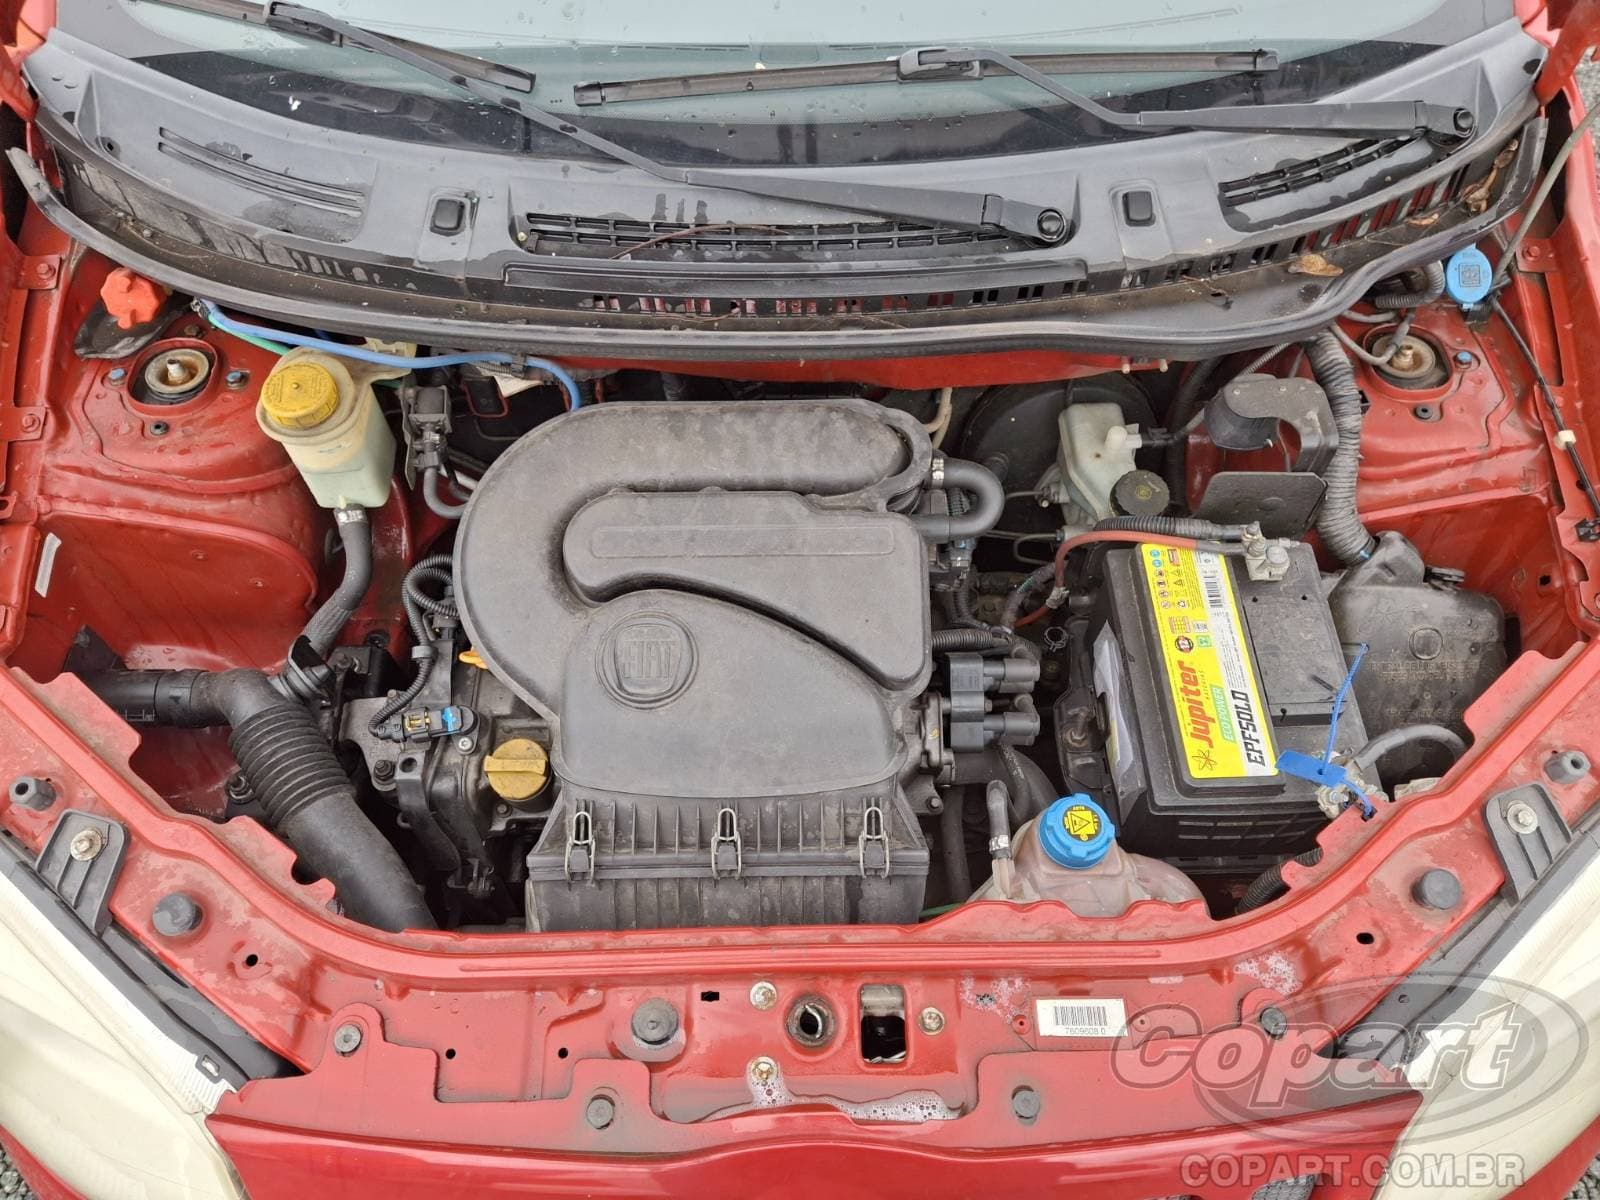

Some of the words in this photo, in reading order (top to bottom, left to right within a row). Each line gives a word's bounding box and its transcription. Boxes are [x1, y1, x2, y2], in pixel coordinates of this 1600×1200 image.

[621, 639, 675, 679] FIAT
[1211, 687, 1230, 721] POWER
[1219, 721, 1234, 741] ECO
